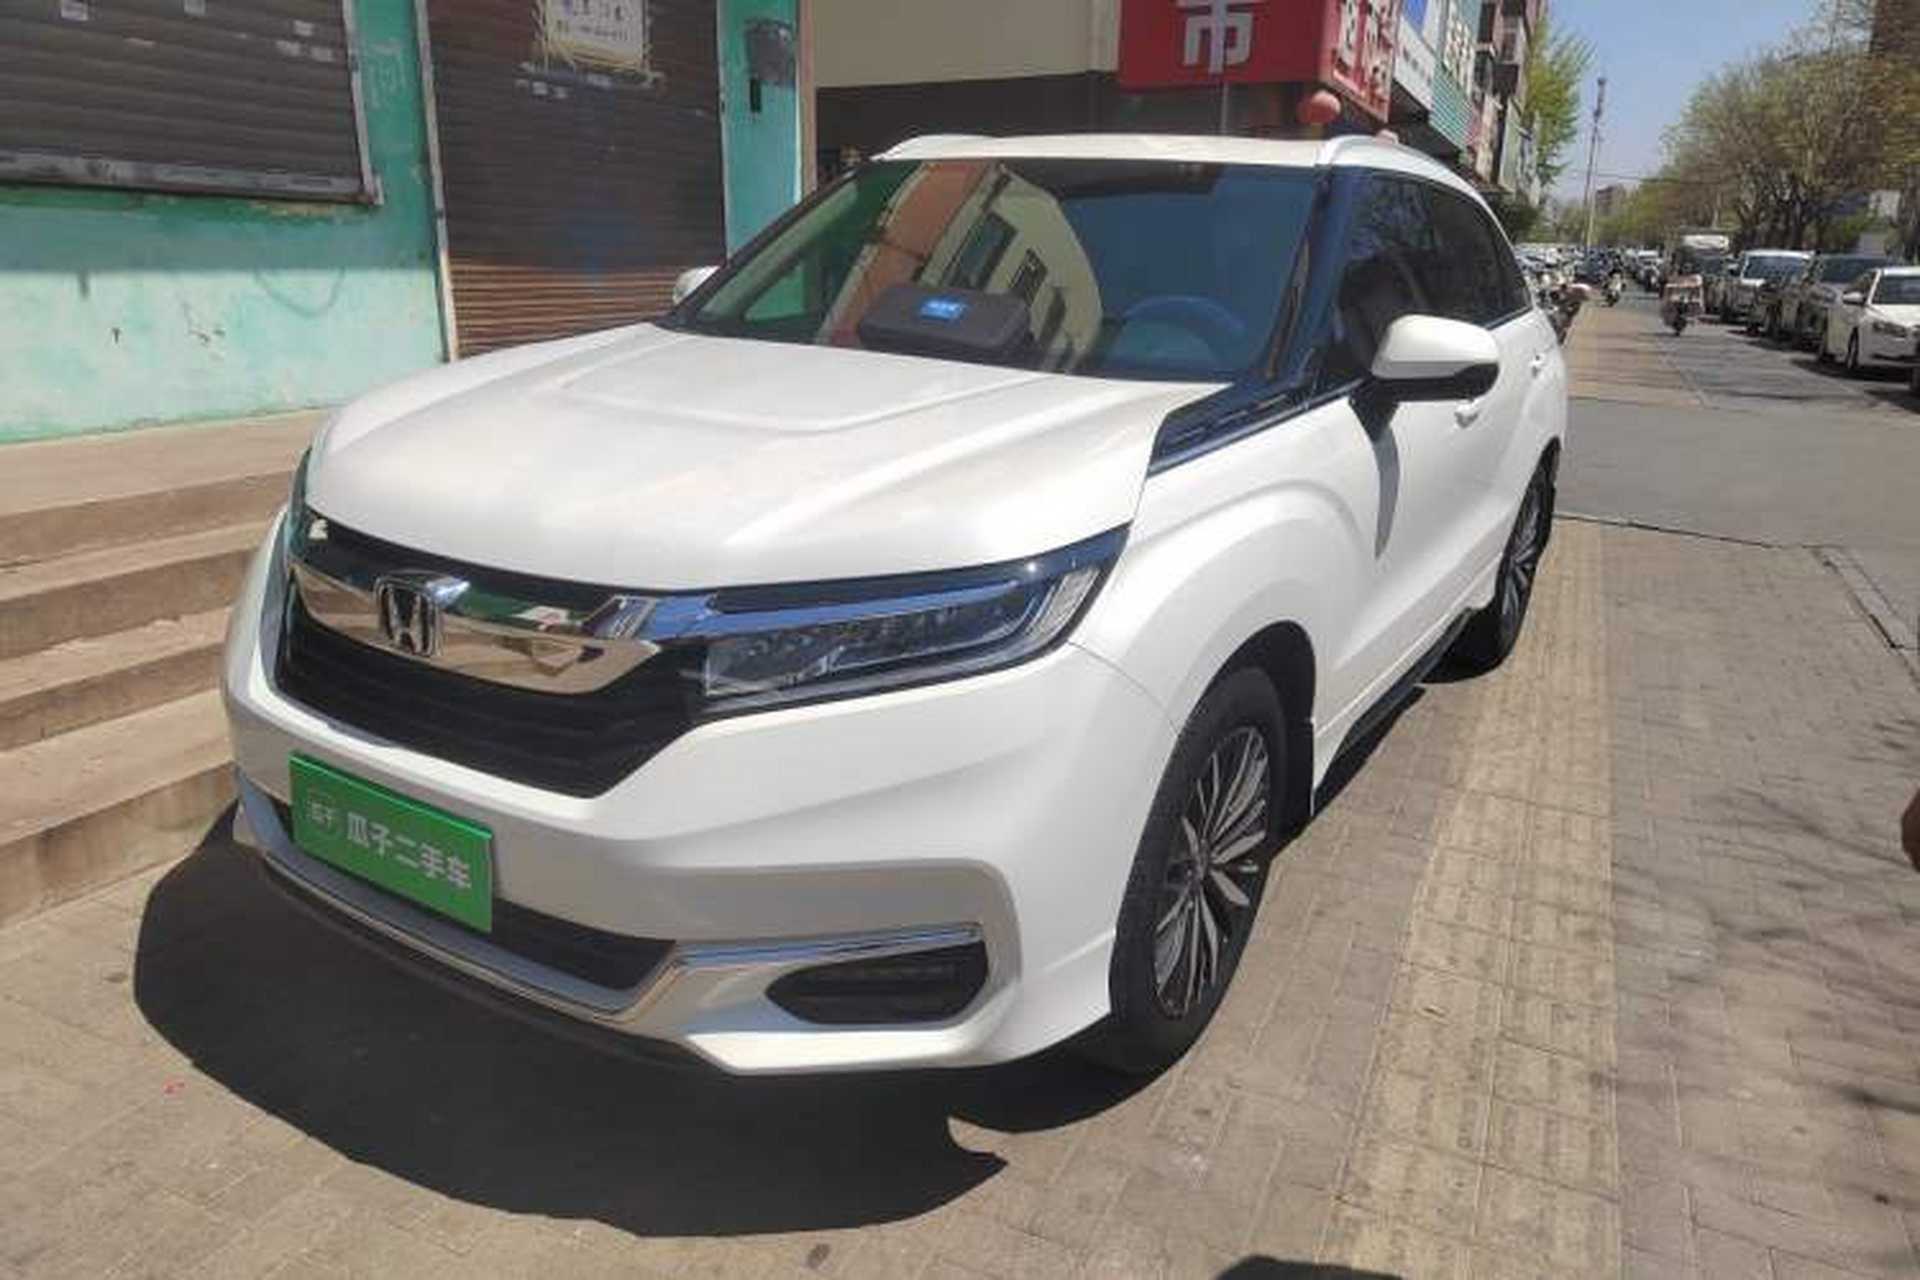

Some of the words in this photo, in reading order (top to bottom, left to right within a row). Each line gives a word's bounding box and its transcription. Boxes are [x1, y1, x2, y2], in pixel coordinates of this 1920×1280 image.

[1177, 0, 1253, 75] 市
[347, 811, 472, 889] 瓜子二手车
